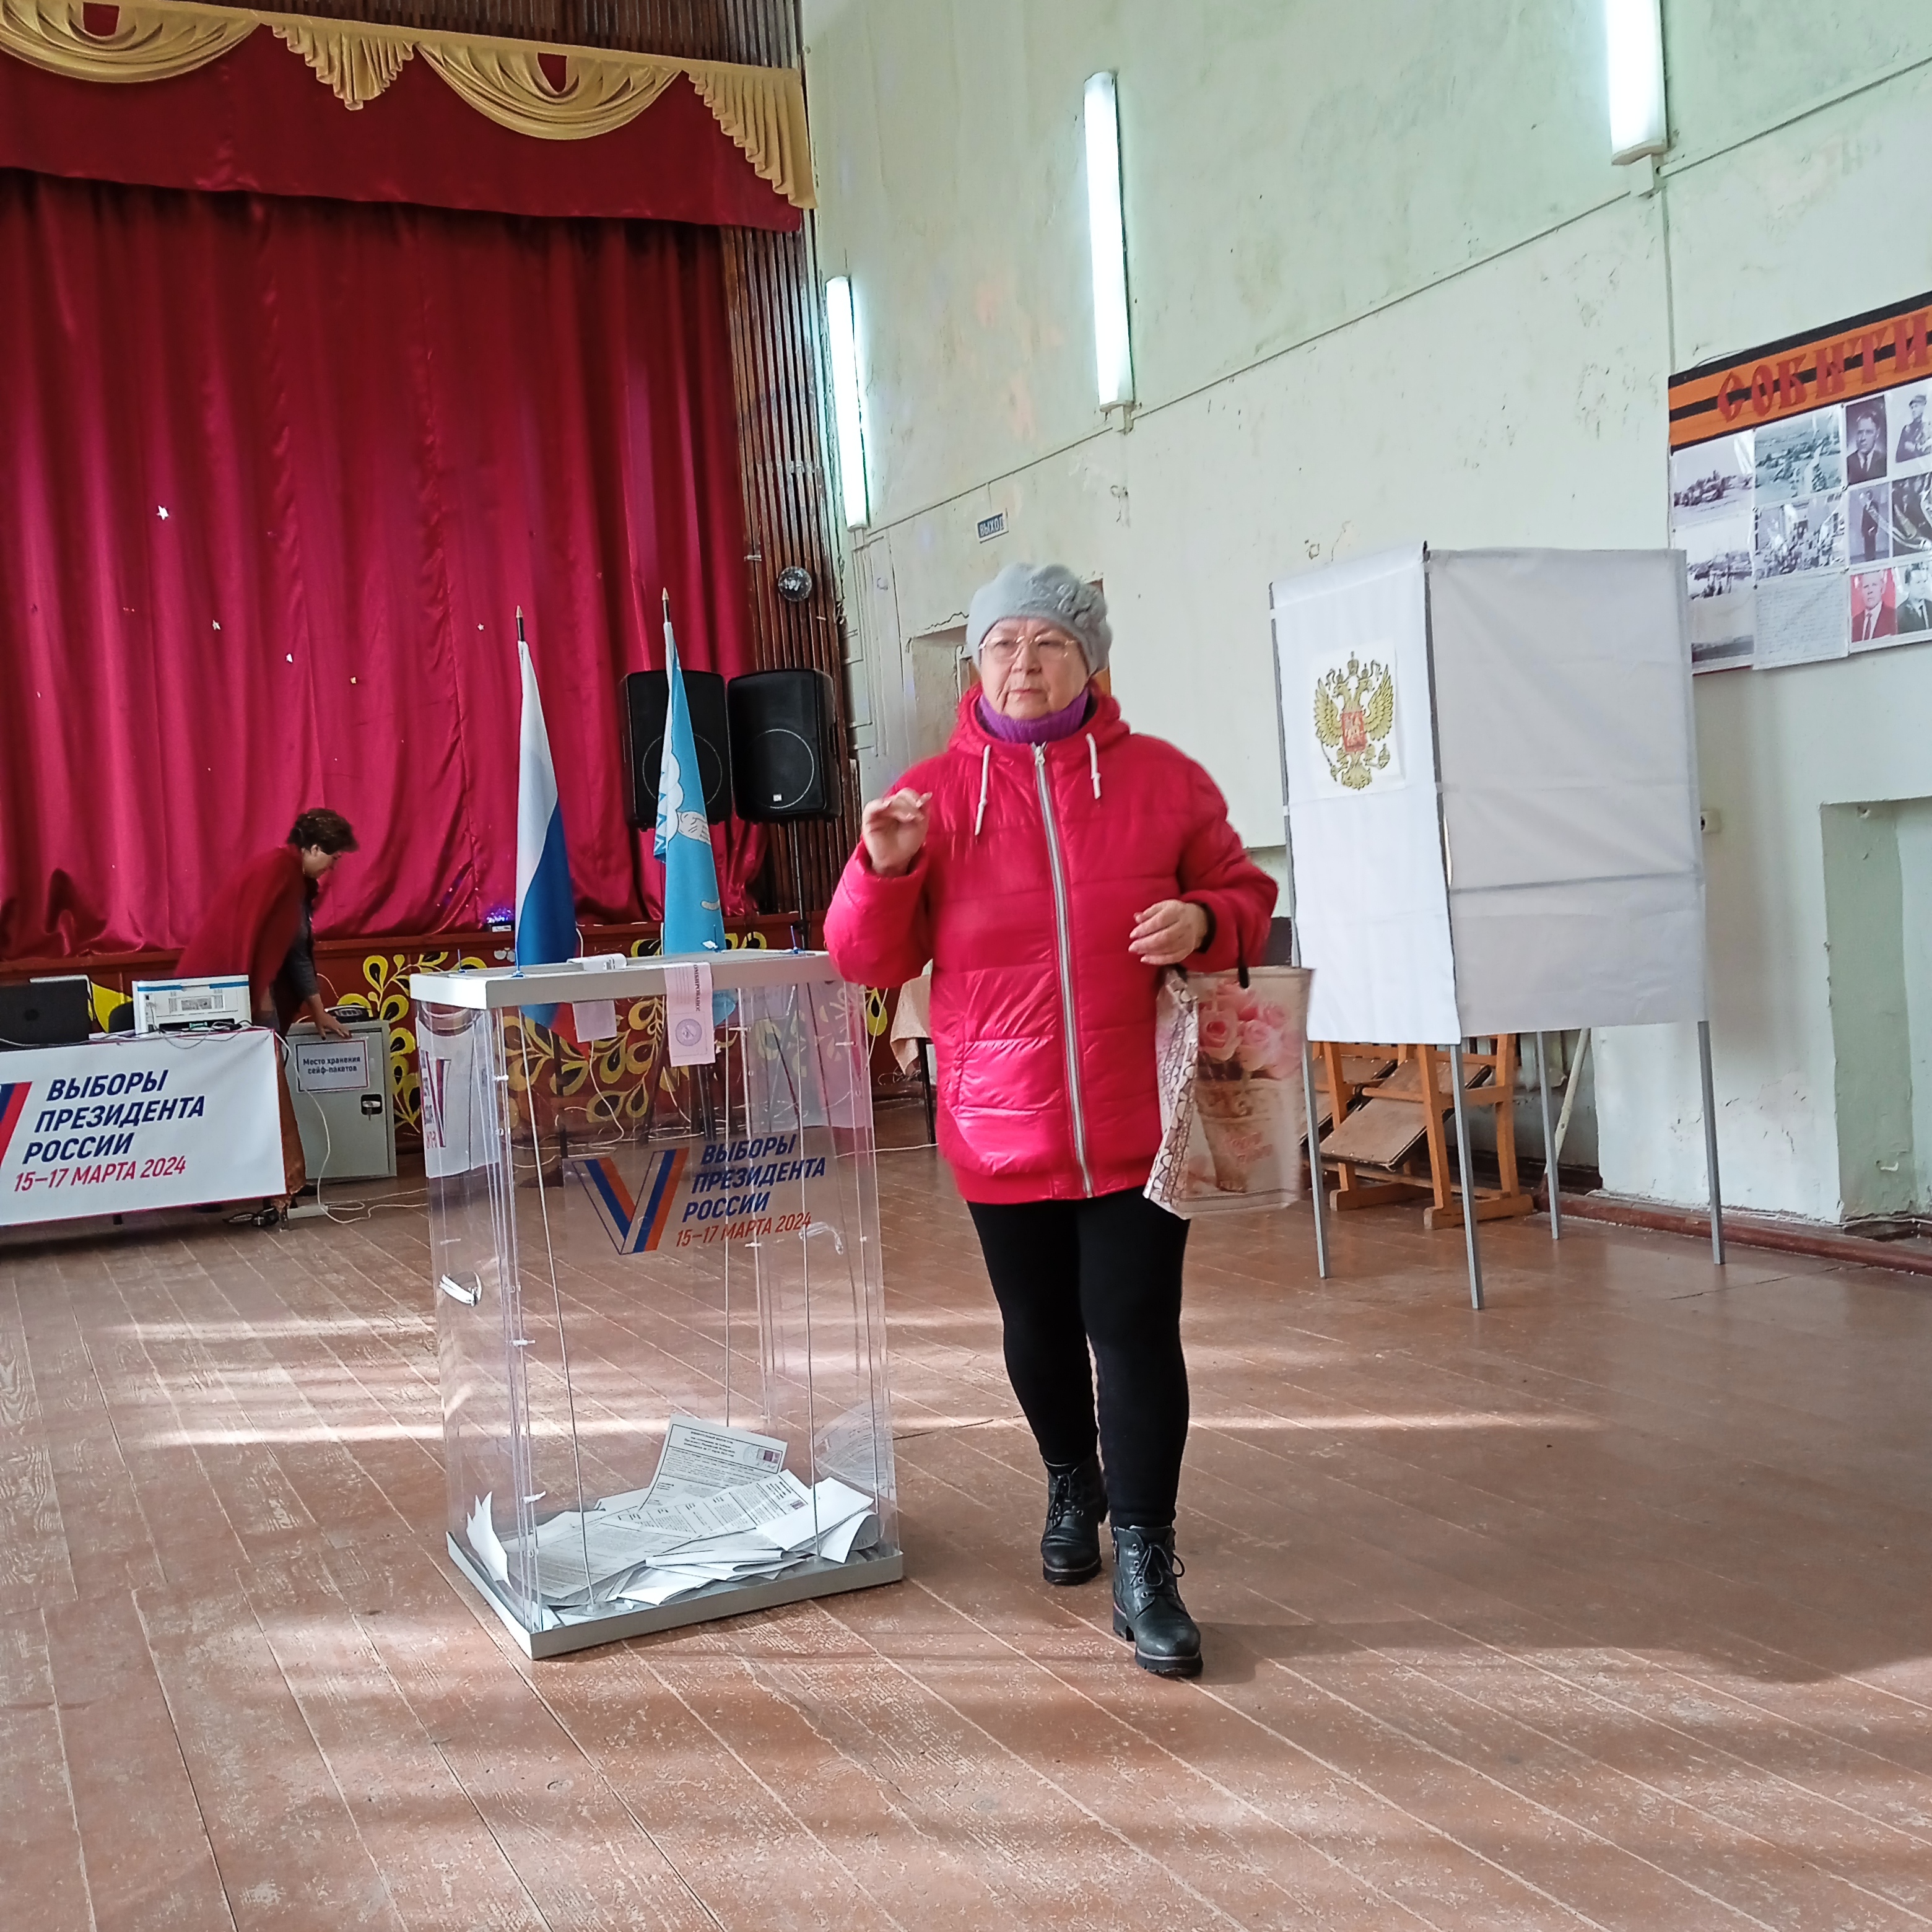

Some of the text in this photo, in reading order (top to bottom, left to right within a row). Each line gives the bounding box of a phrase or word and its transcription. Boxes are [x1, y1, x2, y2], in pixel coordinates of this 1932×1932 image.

[308, 1066, 357, 1075] сейф-пакетов
[327, 1056, 360, 1065] хранения
[46, 1069, 169, 1102] ВЫБОРЫ
[34, 1095, 205, 1133] ПРЕЗИДЕНТА
[22, 1132, 135, 1164] РОССИИ
[700, 1134, 797, 1165] ВЫБОРЫ
[70, 1161, 136, 1186] МАРТА
[140, 1155, 186, 1178] 2024
[692, 1157, 825, 1194] ПРЕЗИДЕНТА
[682, 1191, 770, 1223] РОССИИ
[720, 1217, 772, 1242] МАРТА
[776, 1212, 811, 1233] 2024
